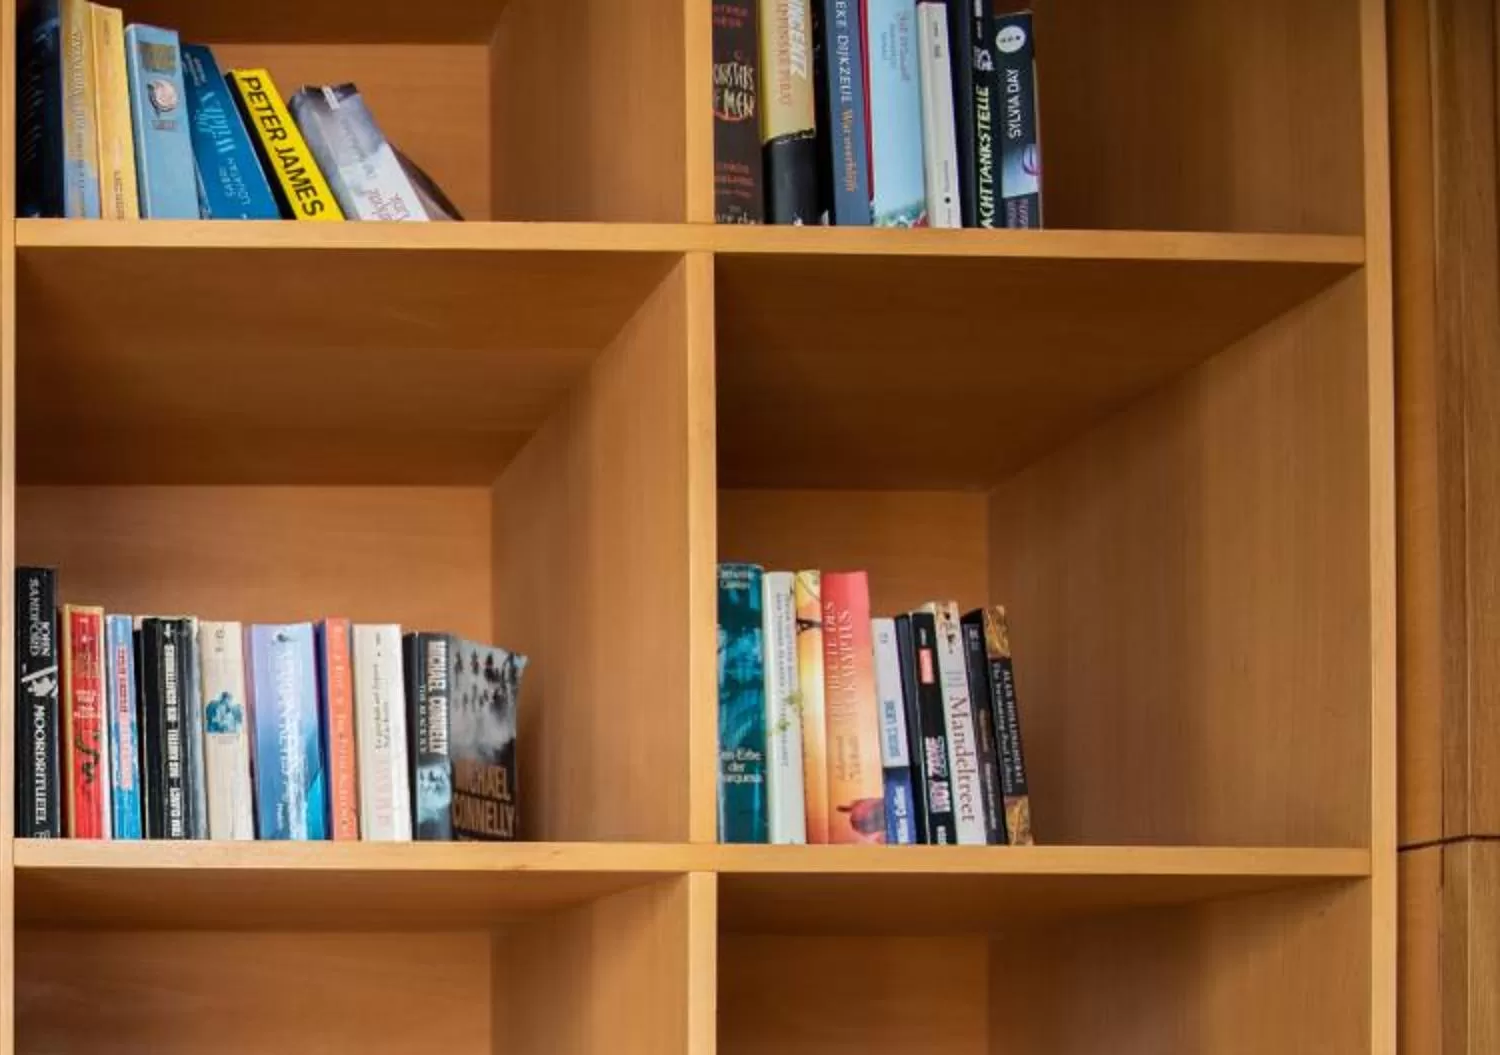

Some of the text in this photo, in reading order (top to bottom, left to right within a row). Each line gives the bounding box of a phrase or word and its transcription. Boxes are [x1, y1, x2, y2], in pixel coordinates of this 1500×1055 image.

[836, 35, 853, 105] DIJKZEUL
[1005, 68, 1022, 140] SYLVIA DAY
[239, 76, 325, 218] PETER JAMES
[975, 85, 995, 229] ACHTTANKSTELLE
[27, 577, 42, 658] SANDFORD
[40, 620, 52, 658] JOHN
[426, 640, 450, 756] MICHAEL CONNELLY
[35, 704, 49, 825] MOORDRITUEEL
